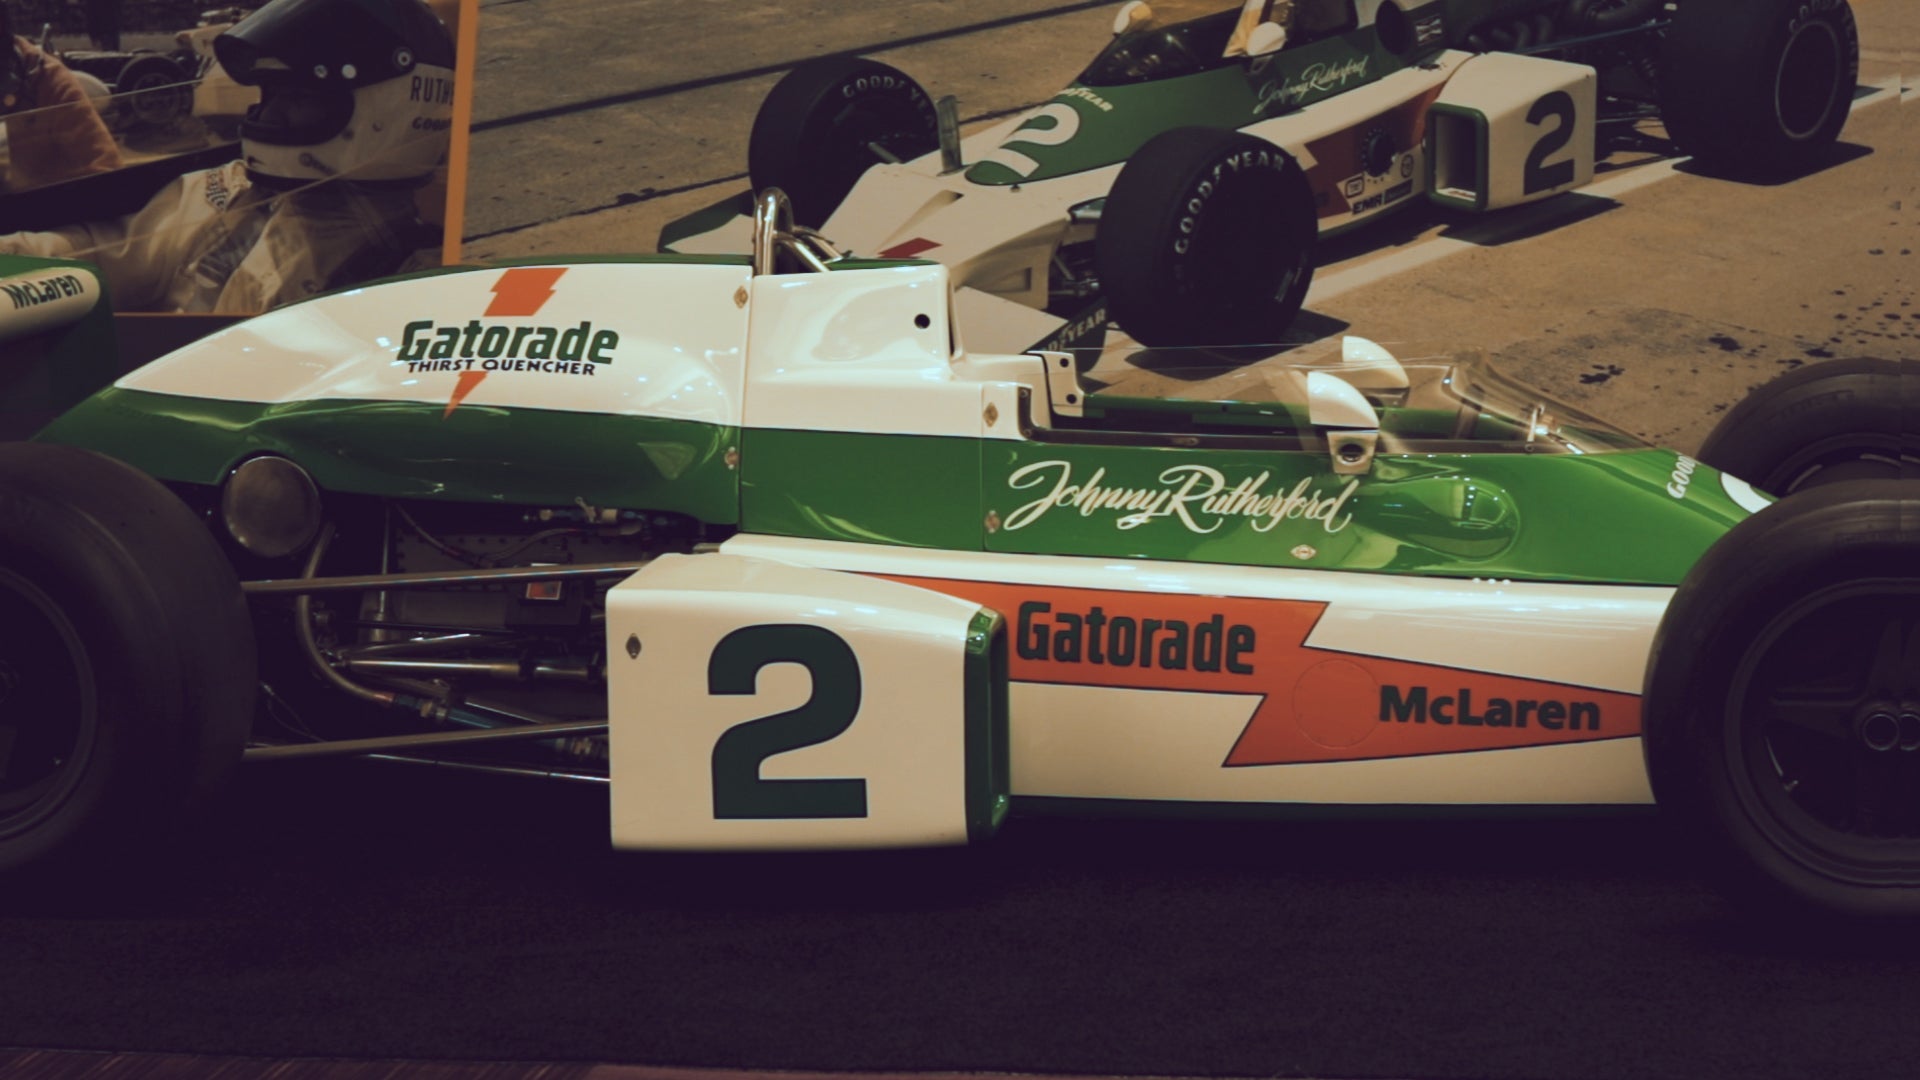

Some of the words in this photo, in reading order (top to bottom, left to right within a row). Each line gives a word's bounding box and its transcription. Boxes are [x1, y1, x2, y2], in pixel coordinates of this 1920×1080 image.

[1523, 90, 1575, 195] 2
[0, 275, 84, 310] McLaren
[395, 319, 620, 366] Gatorade
[407, 358, 476, 374] THIRST
[480, 358, 597, 377] QUENCHER
[1002, 460, 1176, 532] Johnny
[1158, 463, 1360, 534] Rutherford
[1016, 600, 1257, 676] Gatorade
[707, 622, 869, 820] 2
[1378, 683, 1601, 731] McLaren
